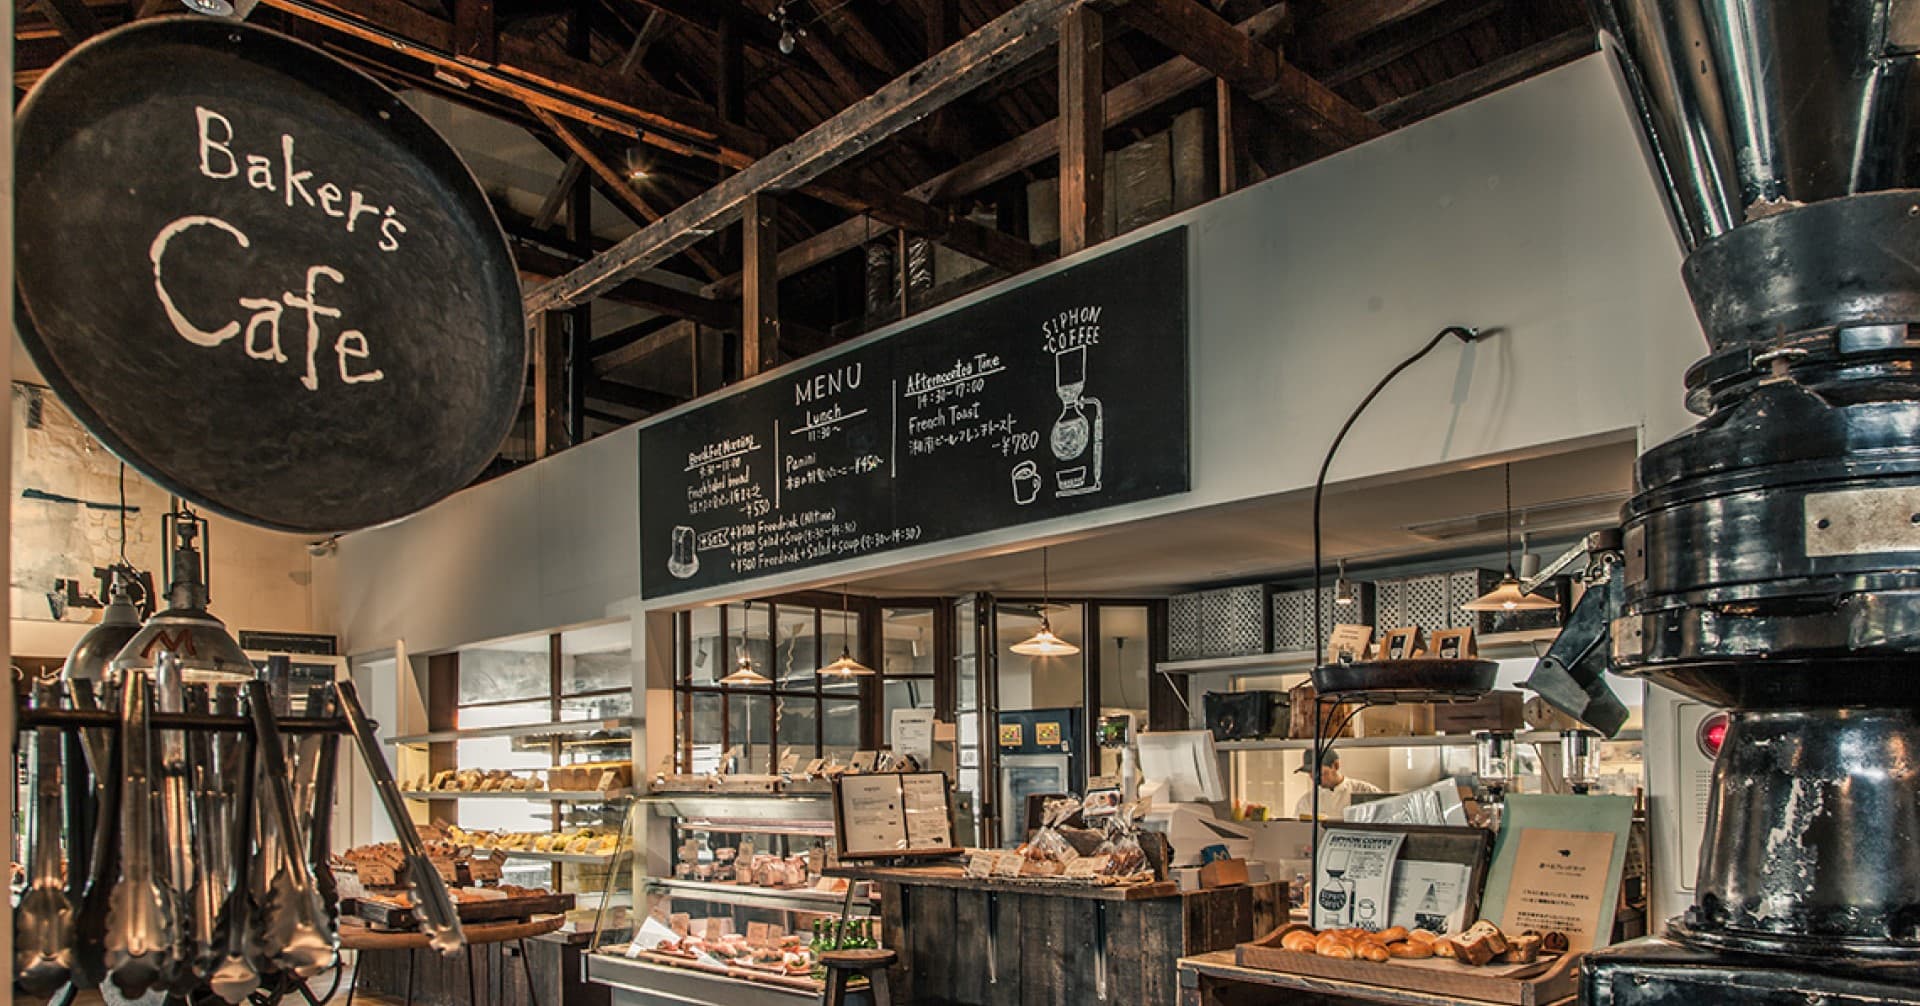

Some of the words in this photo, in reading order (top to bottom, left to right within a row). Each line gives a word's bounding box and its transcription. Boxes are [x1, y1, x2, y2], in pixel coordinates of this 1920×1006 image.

[196, 106, 407, 252] Baker's
[149, 214, 384, 391] Cafe
[1042, 306, 1103, 338] SIPHON
[1047, 326, 1101, 353] COFFEE
[795, 362, 862, 406] MENU
[806, 403, 842, 428] Lunch
[909, 407, 946, 435] French
